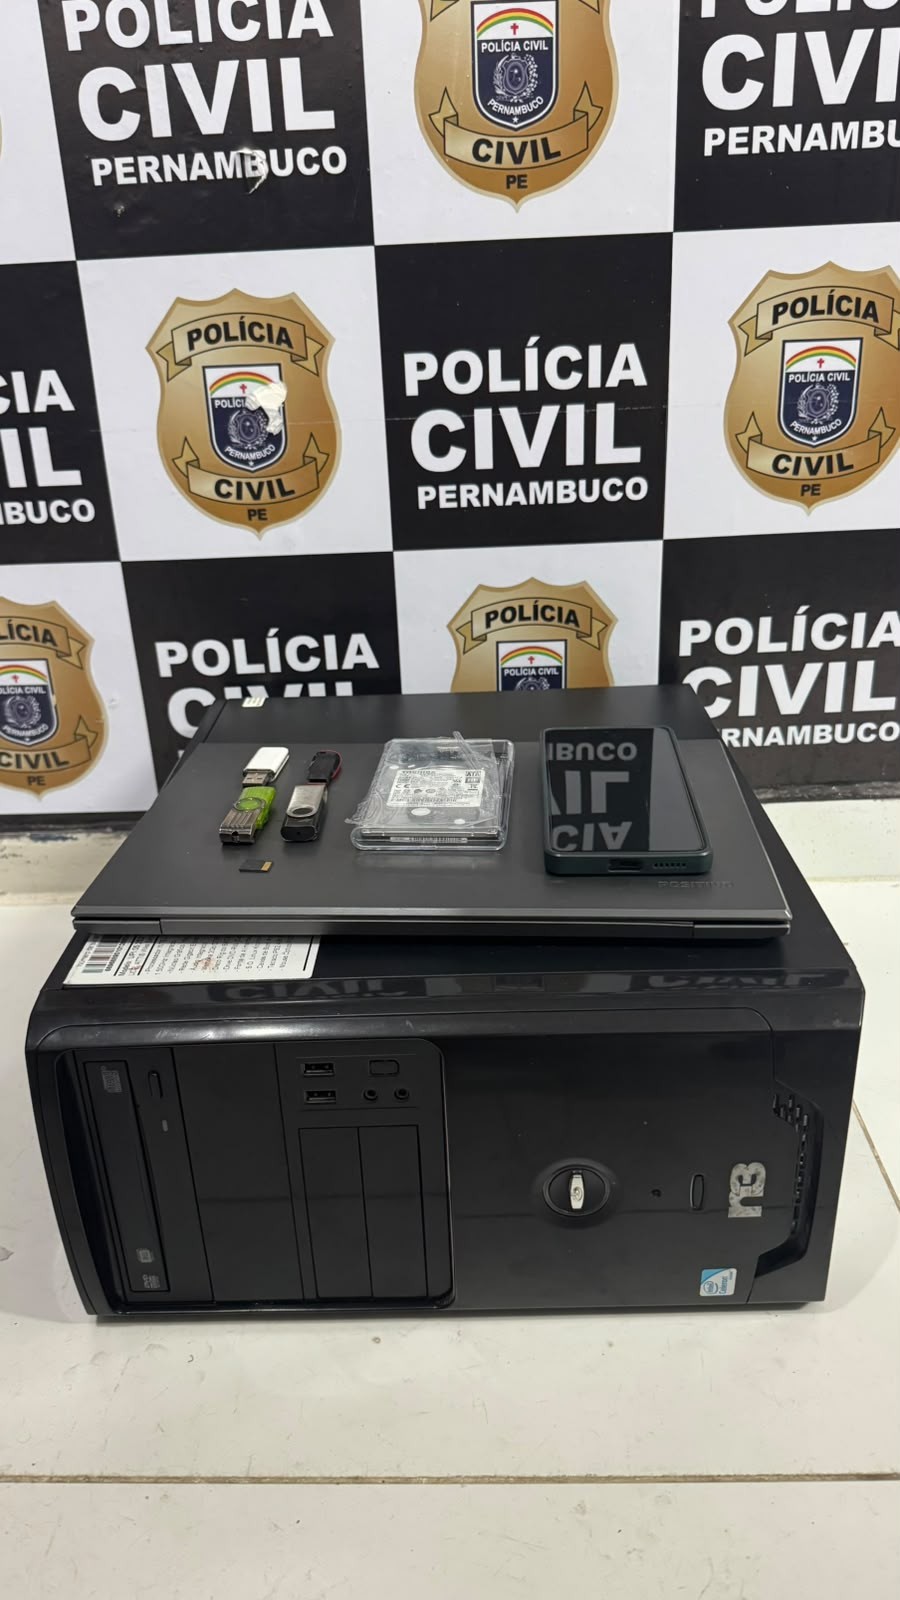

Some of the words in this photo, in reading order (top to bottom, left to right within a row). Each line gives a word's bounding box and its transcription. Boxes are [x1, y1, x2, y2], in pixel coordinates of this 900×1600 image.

[481, 38, 521, 53] POLÍCIA
[523, 39, 549, 52] CIVIL
[78, 57, 336, 142] CIVIL
[487, 96, 544, 116] PERNAMBUCO
[471, 137, 561, 165] CIVIL
[91, 146, 348, 187] PERNAMBUCO
[505, 175, 528, 190] PE
[771, 289, 880, 326] POLÍCIA
[186, 315, 294, 351] POLÍCIA
[403, 336, 648, 397] POLÍCIA
[788, 371, 825, 383] POLÍCIA
[827, 371, 851, 382] CIVIL
[214, 396, 246, 409] POLÍCI
[410, 402, 642, 473] CIVIL
[789, 418, 842, 436] PERNAMBUCO
[224, 444, 276, 461] PERNAMBUCO
[771, 453, 854, 477] CIVIL
[214, 478, 296, 501] CIVIL
[417, 476, 649, 510] PERNAMBUCO
[800, 484, 821, 497] PE
[0, 499, 96, 525] BUCO
[247, 508, 268, 521] PE
[485, 600, 580, 629] POLÍCIA
[679, 605, 900, 657] POLÍCIA
[154, 627, 381, 679] POLÍCIA
[503, 666, 537, 677] POLÍCIA
[537, 667, 560, 676] CIVIL
[24, 686, 47, 695] CIVIL
[682, 660, 897, 719] CIVIL
[2, 723, 49, 737] PERNAMBUCO
[720, 721, 900, 748] RNAMBUCO
[0, 751, 70, 770] CIVIL
[27, 775, 47, 787] PE
